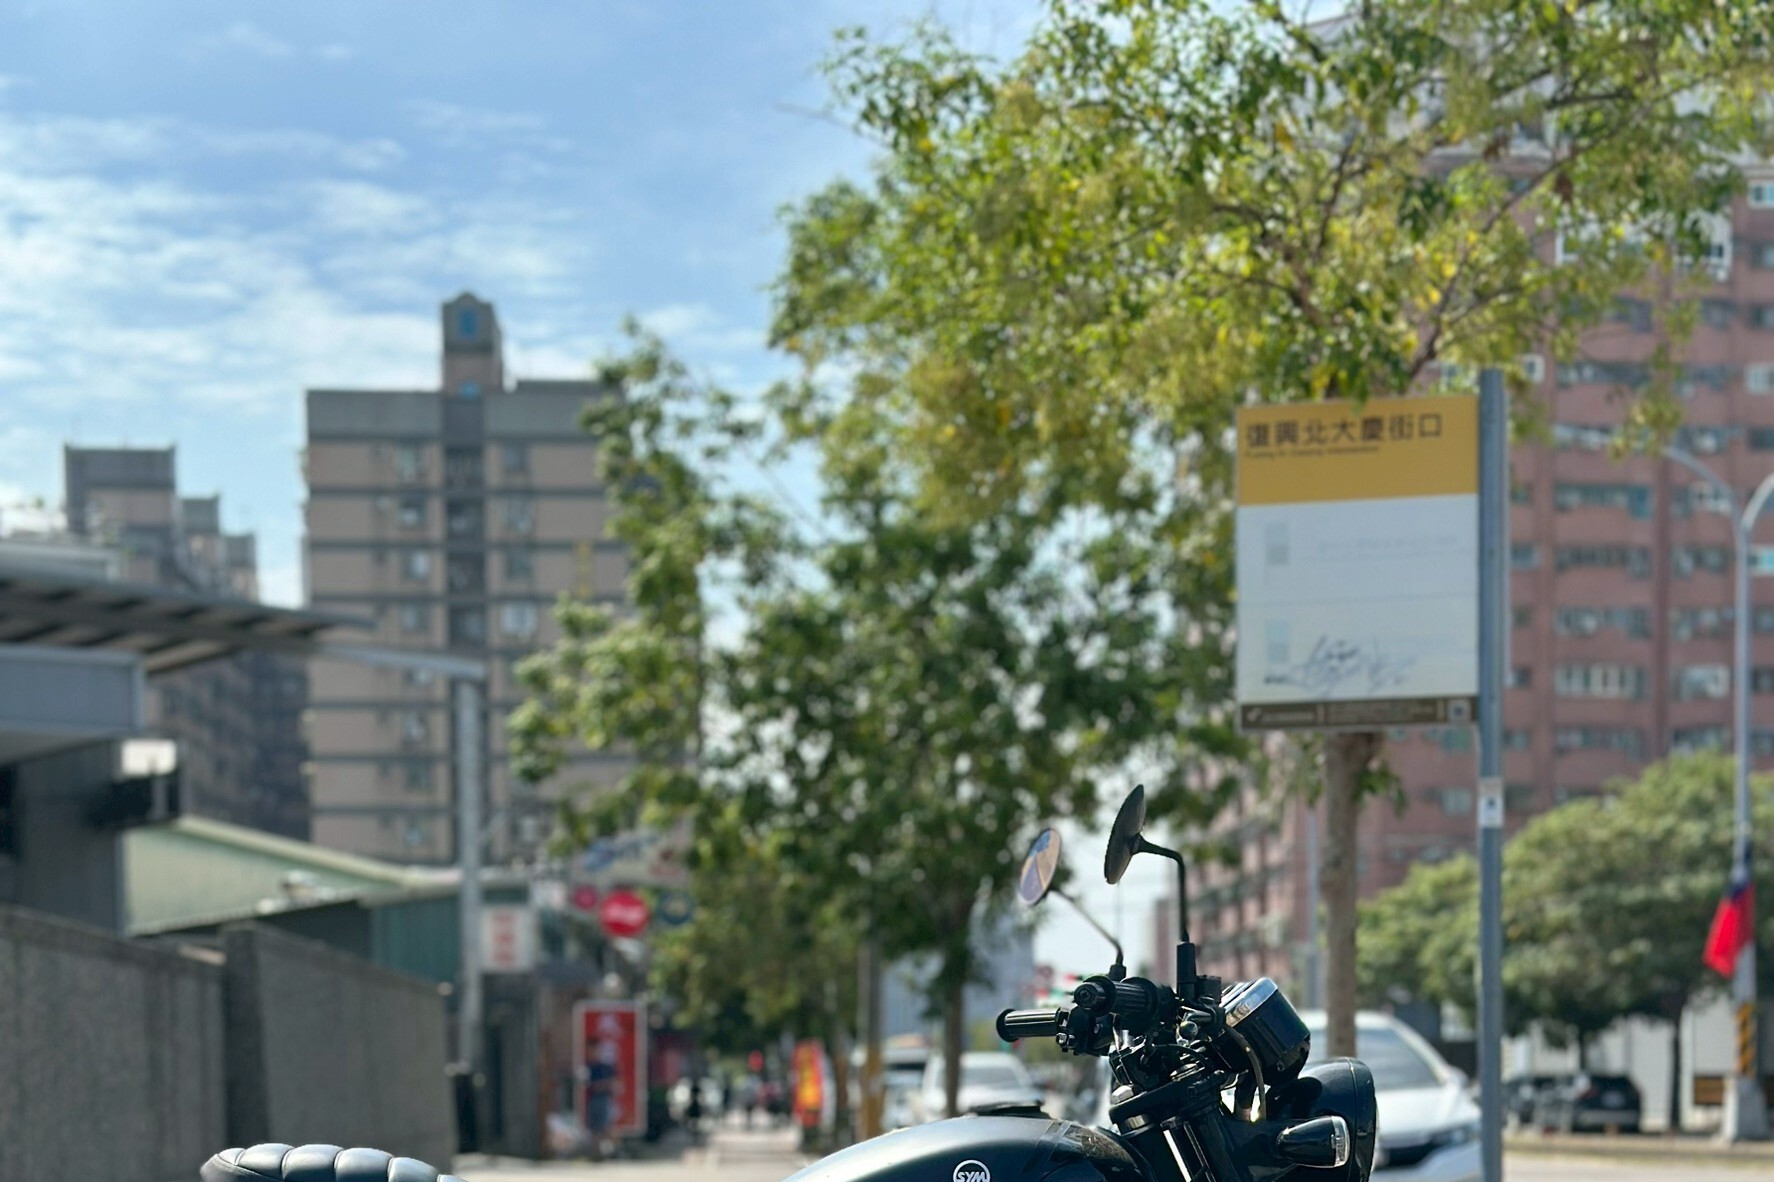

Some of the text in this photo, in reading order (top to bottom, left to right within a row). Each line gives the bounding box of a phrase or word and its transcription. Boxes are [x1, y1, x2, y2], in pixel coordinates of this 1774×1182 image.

[1246, 413, 1442, 447] 復興北大慶街口
